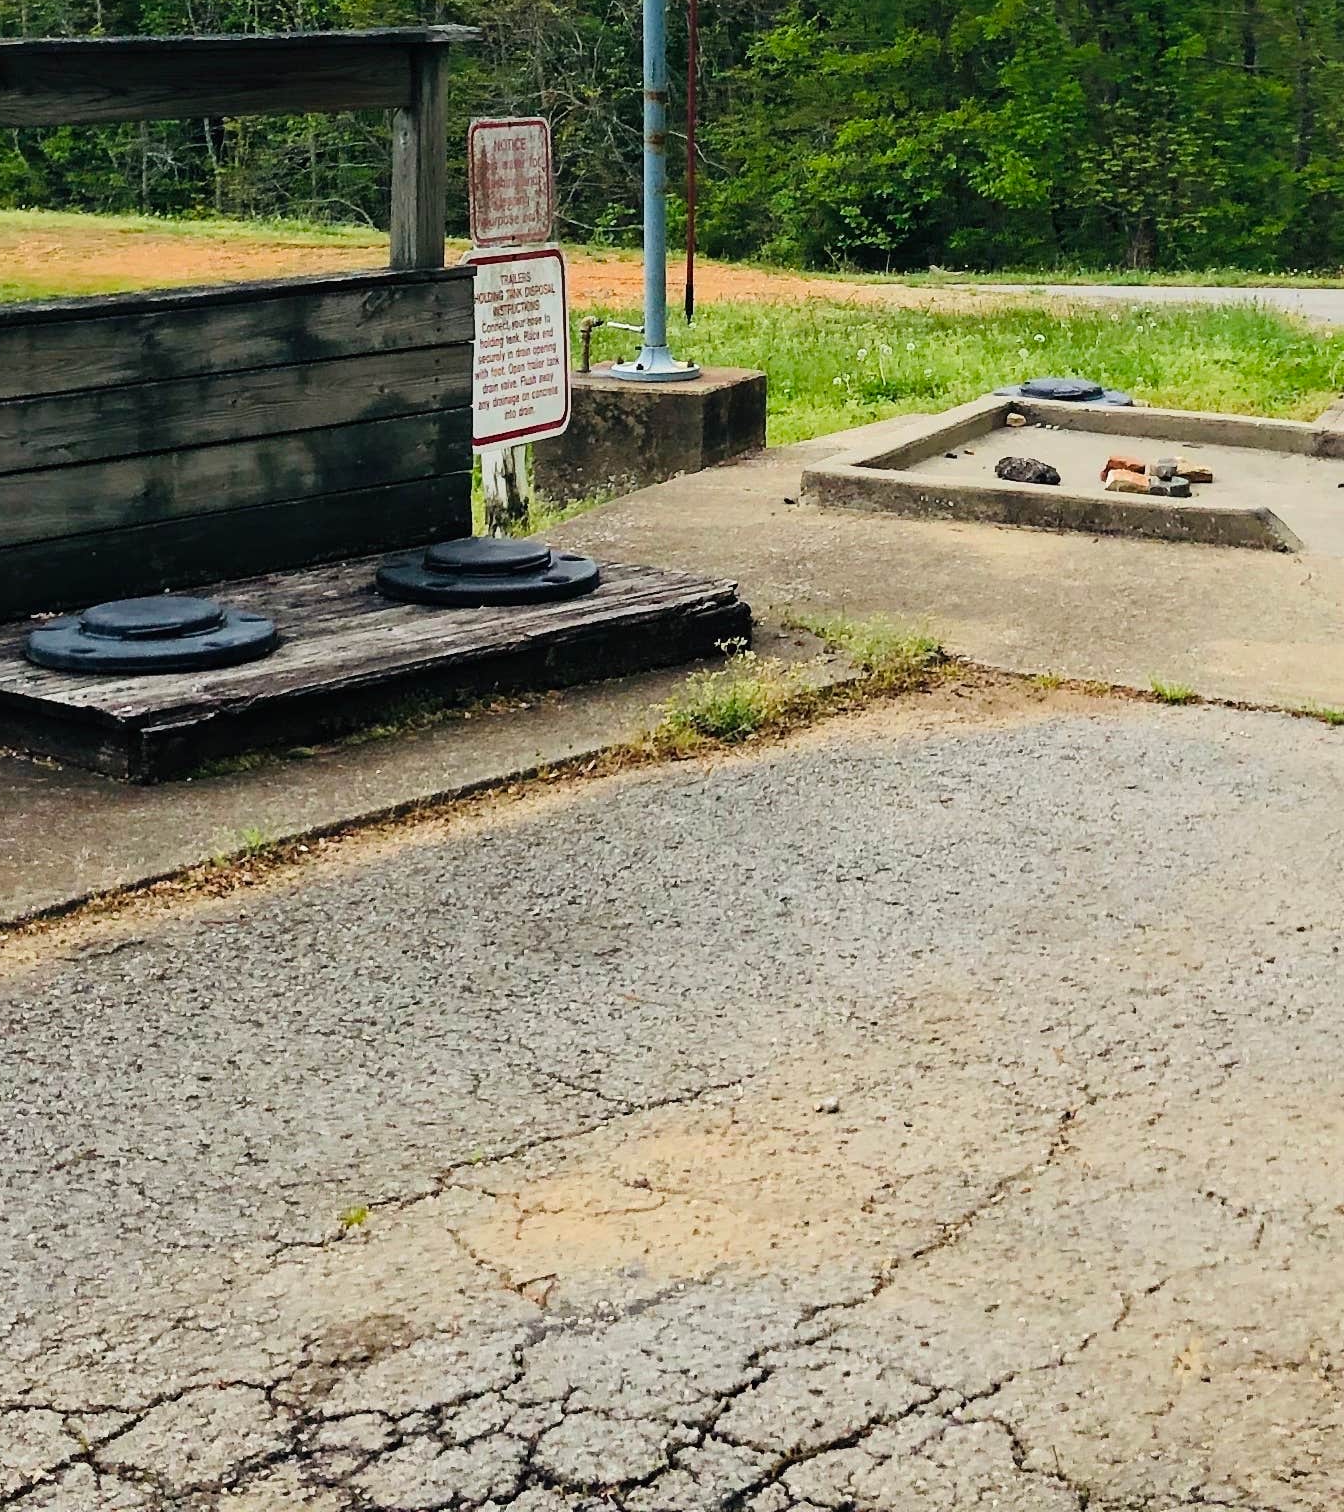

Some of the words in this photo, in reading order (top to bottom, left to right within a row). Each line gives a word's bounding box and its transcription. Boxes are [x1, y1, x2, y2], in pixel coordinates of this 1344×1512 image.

[493, 137, 527, 152] NOTICE
[500, 272, 532, 286] TRAILERS
[506, 288, 523, 300] TANK
[525, 284, 556, 297] DISPOSAL
[493, 300, 540, 316] INSTRUCTIONS
[512, 319, 526, 331] your
[479, 338, 504, 349] holding
[478, 350, 505, 364] securely
[516, 347, 531, 358] drain
[533, 344, 557, 355] opening
[474, 369, 489, 380] with
[508, 363, 525, 374] Open
[527, 358, 545, 370] trailer
[546, 357, 560, 367] tank
[482, 384, 499, 394] drain
[520, 375, 537, 387] Flush
[478, 401, 490, 411] any
[493, 395, 520, 407] drainage
[522, 393, 530, 401] on
[532, 386, 558, 399] concrete
